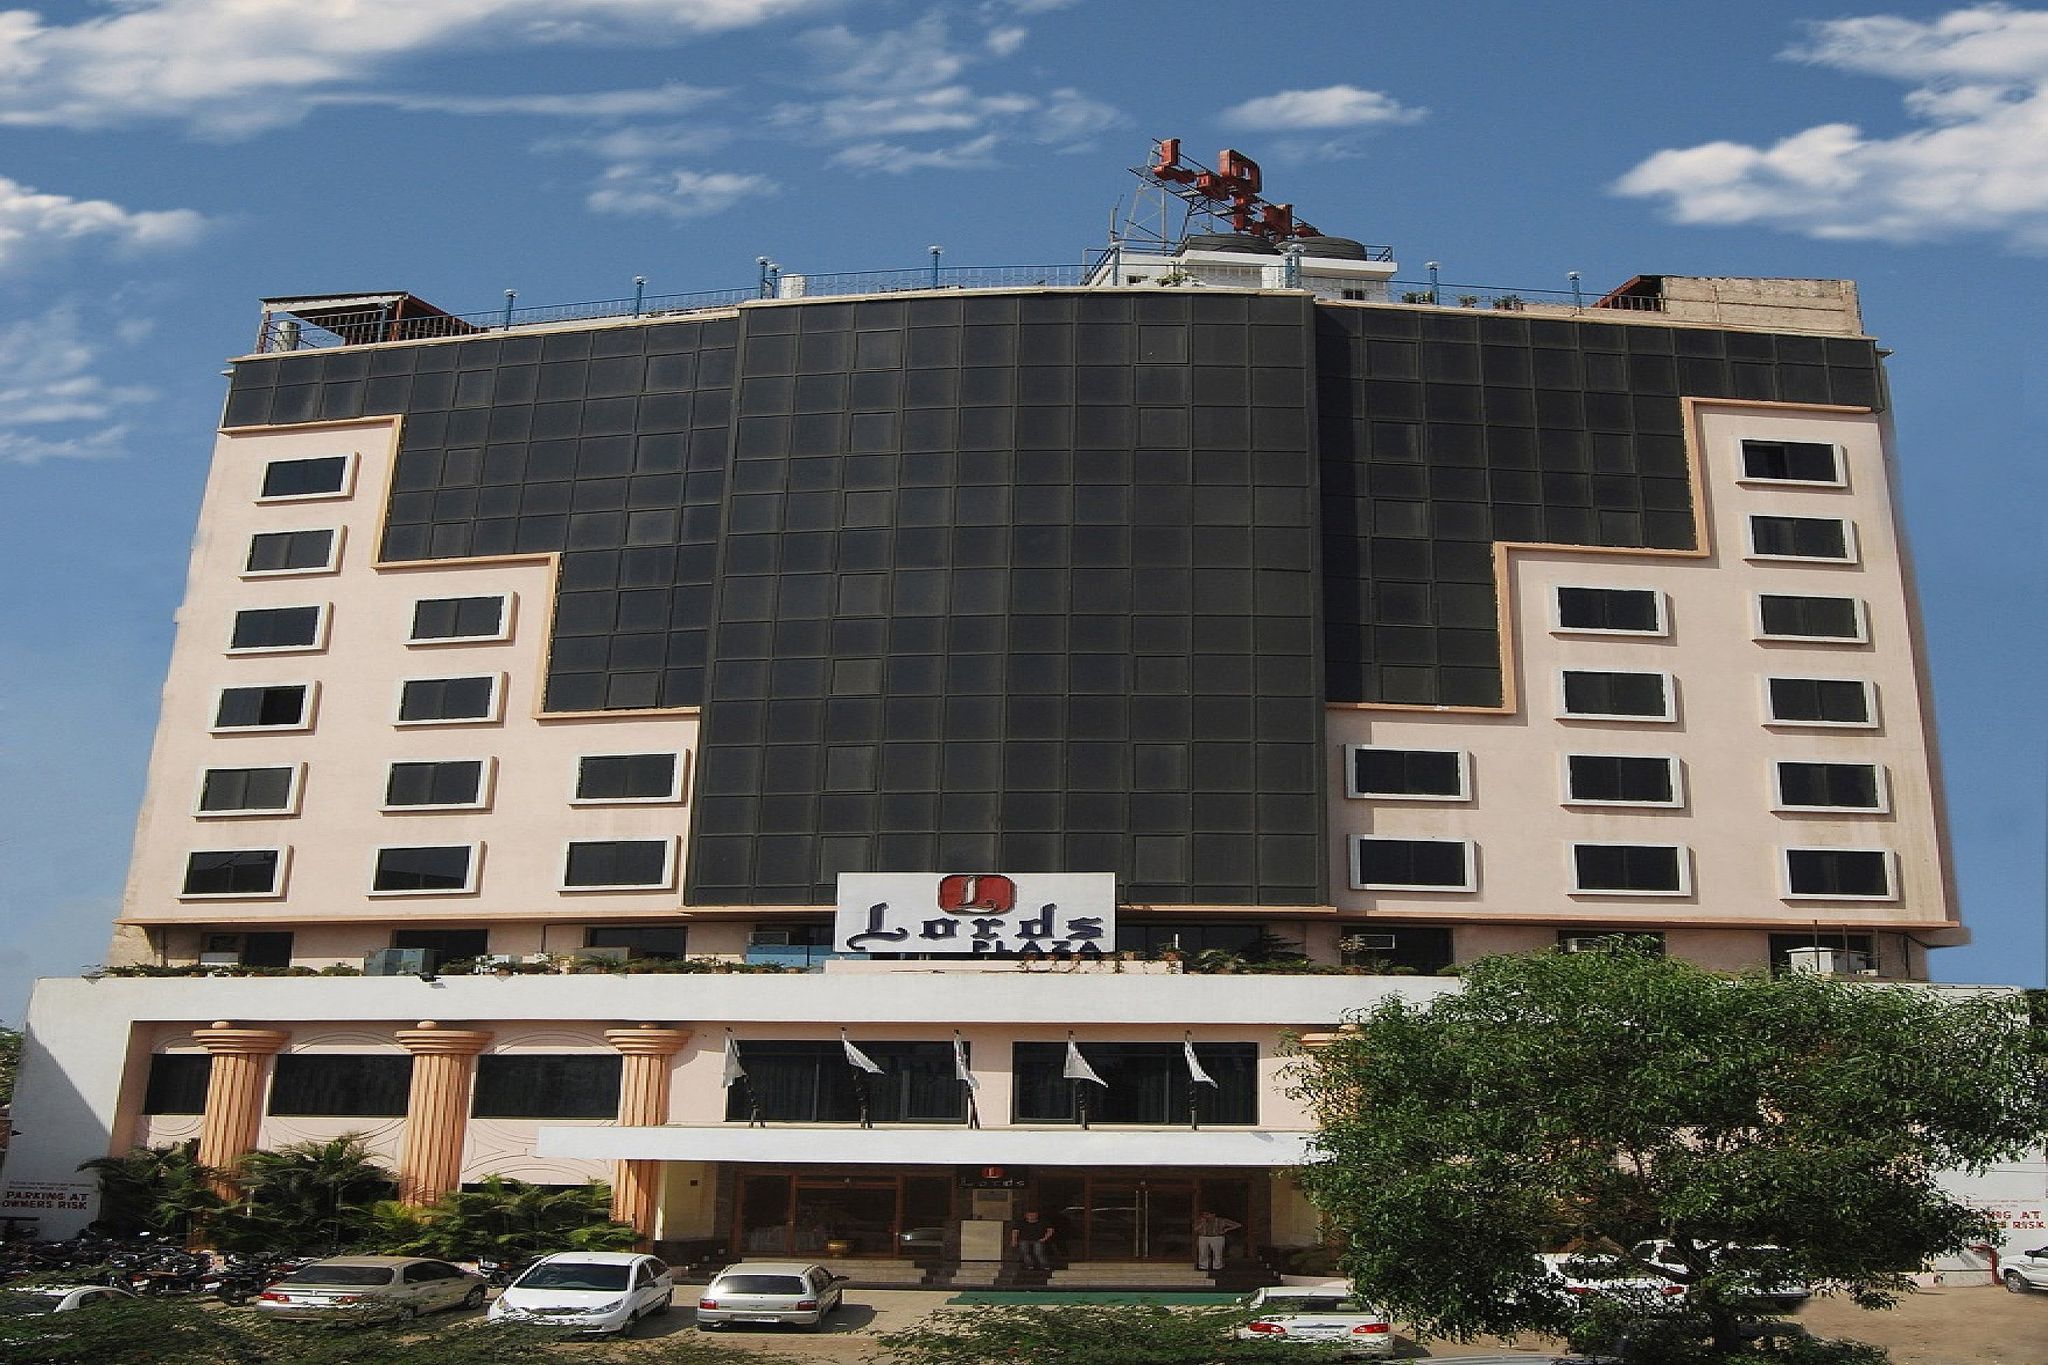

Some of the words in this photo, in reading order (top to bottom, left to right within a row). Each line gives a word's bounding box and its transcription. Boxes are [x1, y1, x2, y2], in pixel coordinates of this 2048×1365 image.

[846, 902, 1104, 951] Lords
[972, 940, 1101, 953] PLAZA
[7, 1192, 65, 1200] PARKING
[69, 1193, 89, 1201] AT
[2, 1200, 52, 1208] OWNERS
[58, 1201, 87, 1210] RISK
[2020, 1210, 2041, 1219] AT
[2012, 1221, 2046, 1229] RISK
